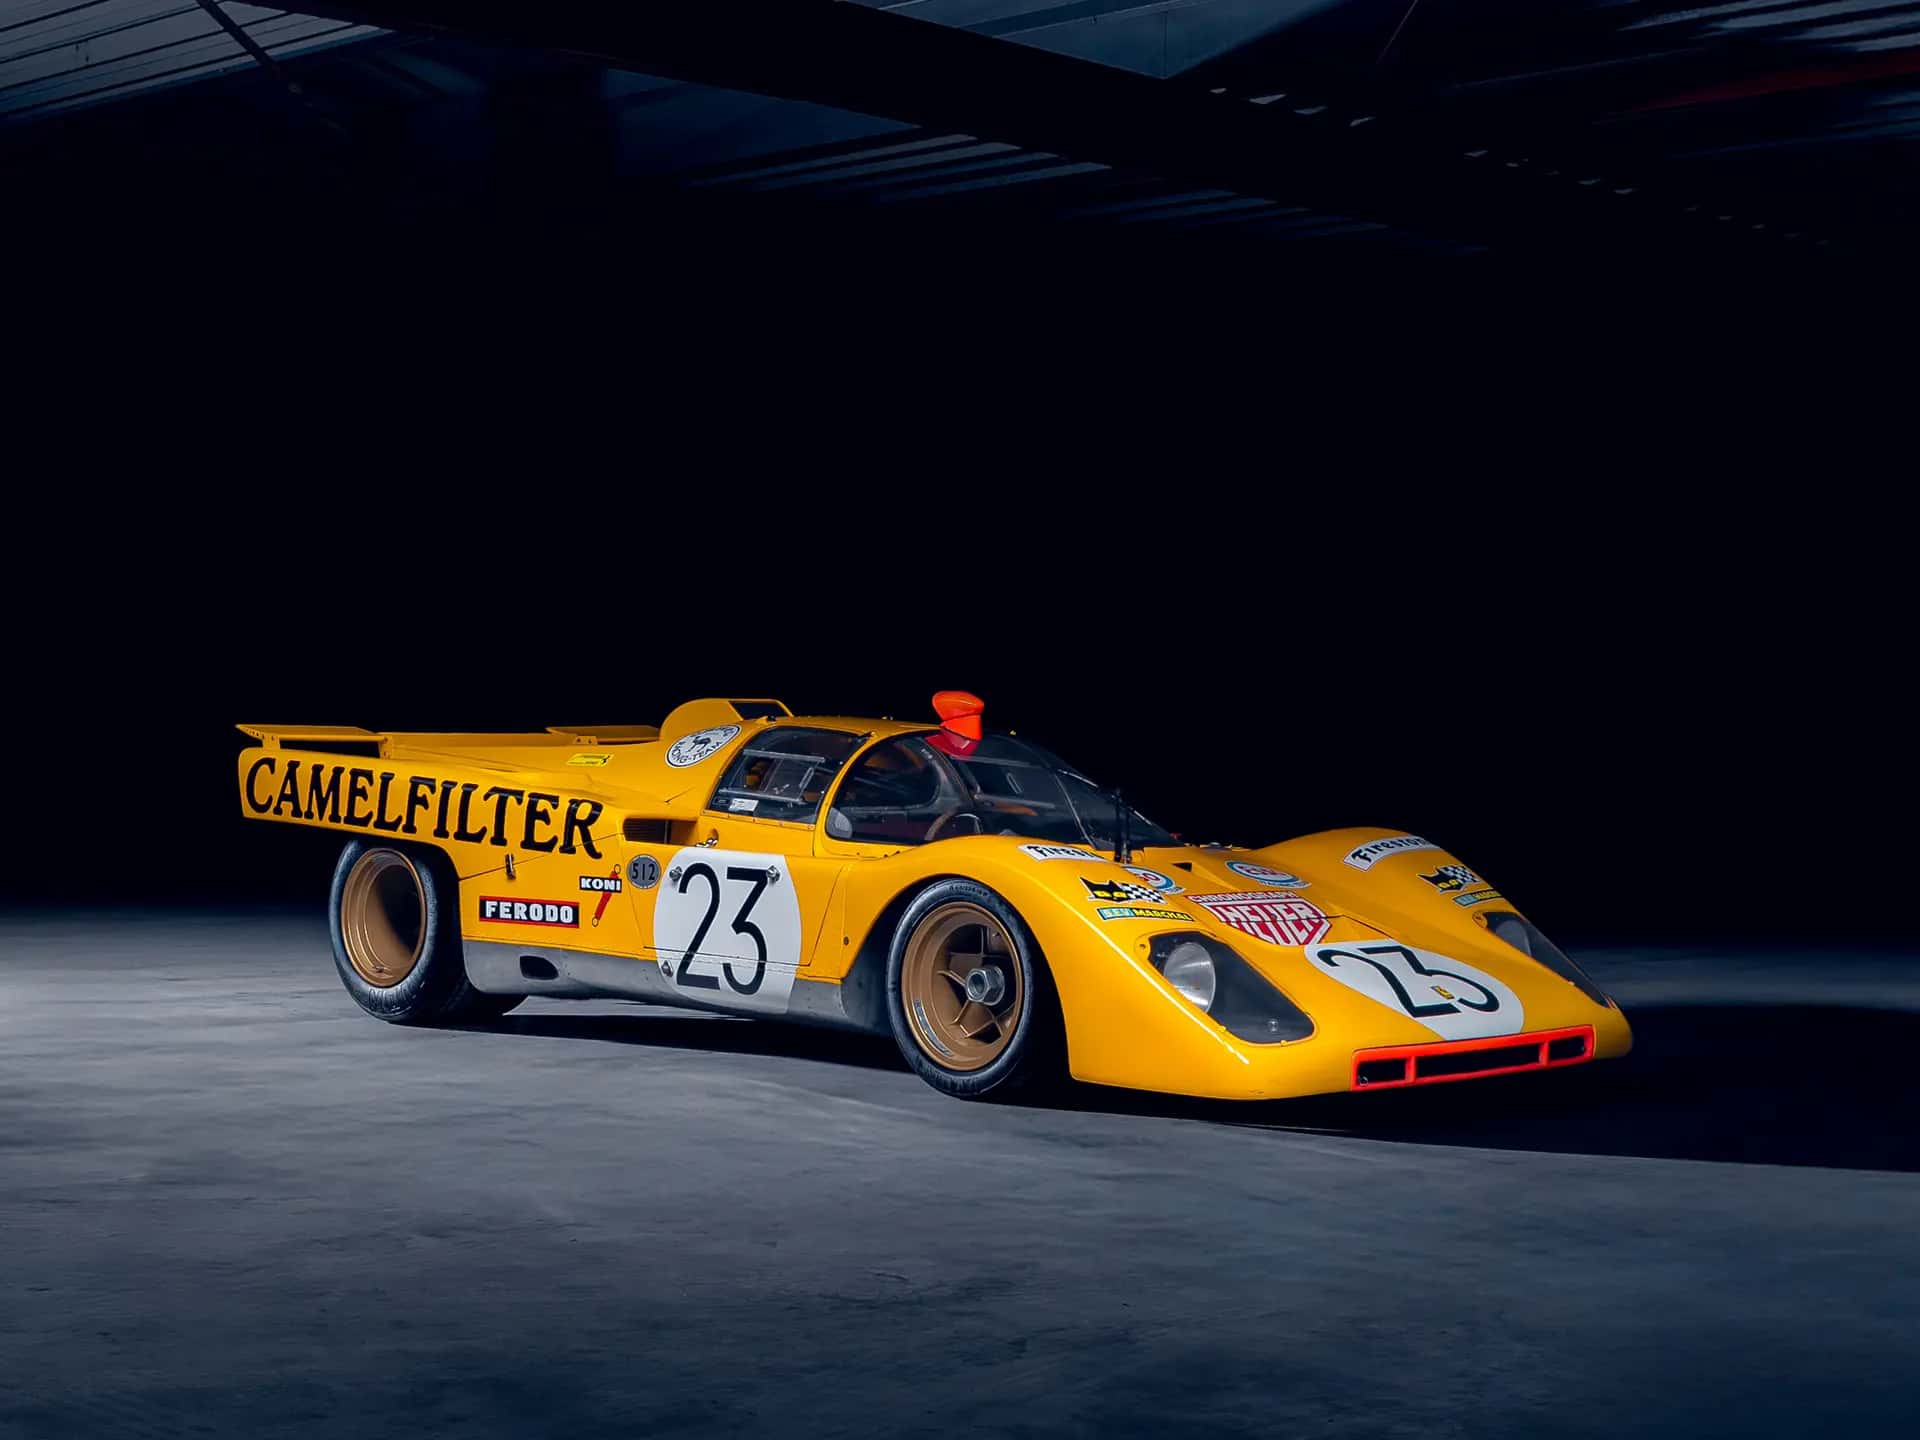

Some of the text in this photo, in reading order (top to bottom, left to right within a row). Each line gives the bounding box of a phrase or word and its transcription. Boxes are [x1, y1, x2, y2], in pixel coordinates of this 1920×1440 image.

[246, 757, 603, 859] CAMELFILTER
[1350, 838, 1428, 862] Firesto
[580, 877, 622, 891] KONI
[632, 863, 656, 881] 512
[484, 900, 574, 924] FERODO
[1213, 903, 1322, 945] HEUER
[676, 862, 769, 996] 23
[1316, 945, 1500, 1018] 23
